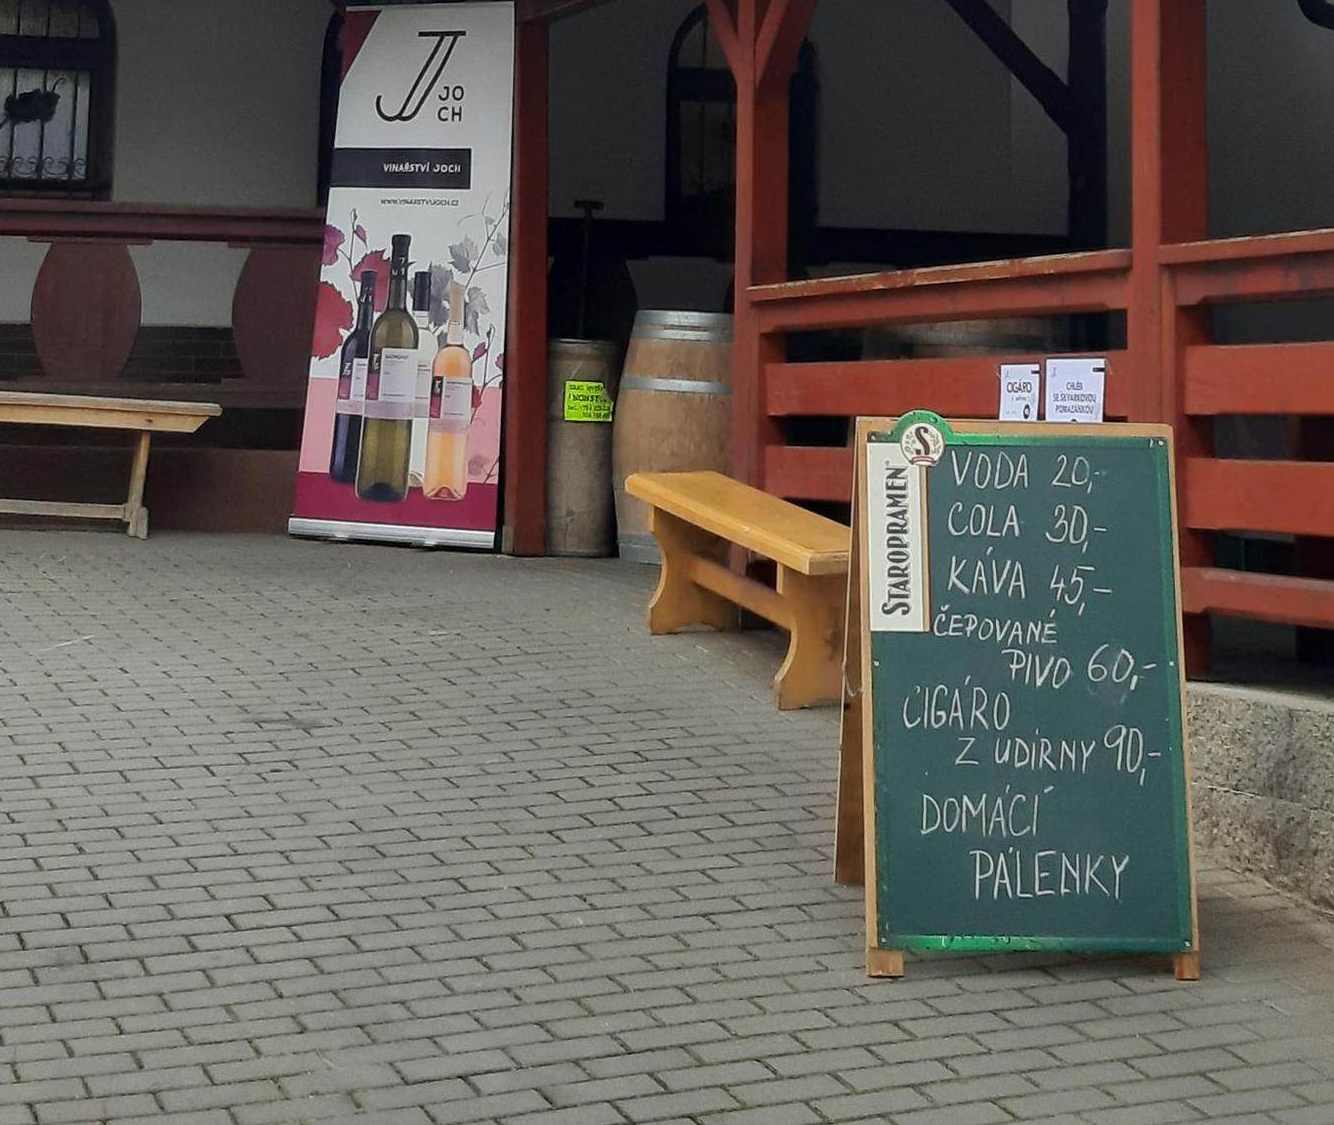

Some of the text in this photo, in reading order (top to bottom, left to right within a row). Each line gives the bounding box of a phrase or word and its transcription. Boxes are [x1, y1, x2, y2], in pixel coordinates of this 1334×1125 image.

[437, 106, 463, 122] CH
[438, 85, 465, 102] JO
[383, 161, 461, 173] VINAŘSTVÍ JOCH
[951, 450, 1104, 494] VODA 20,-
[882, 466, 911, 616] STAROPRAMEN
[948, 501, 1108, 554] COLA 30,-
[948, 546, 1113, 616] KÁVA 45,-
[933, 604, 1058, 645] ČEPOVANÉ
[1001, 644, 1157, 691] PIVO 60,-
[903, 675, 1011, 731] CIGÁRO
[955, 724, 1161, 786] Z UDÍRNY 90,-
[920, 784, 1055, 838] DOMÁCÍ
[969, 846, 1130, 901] PÁLENKY
